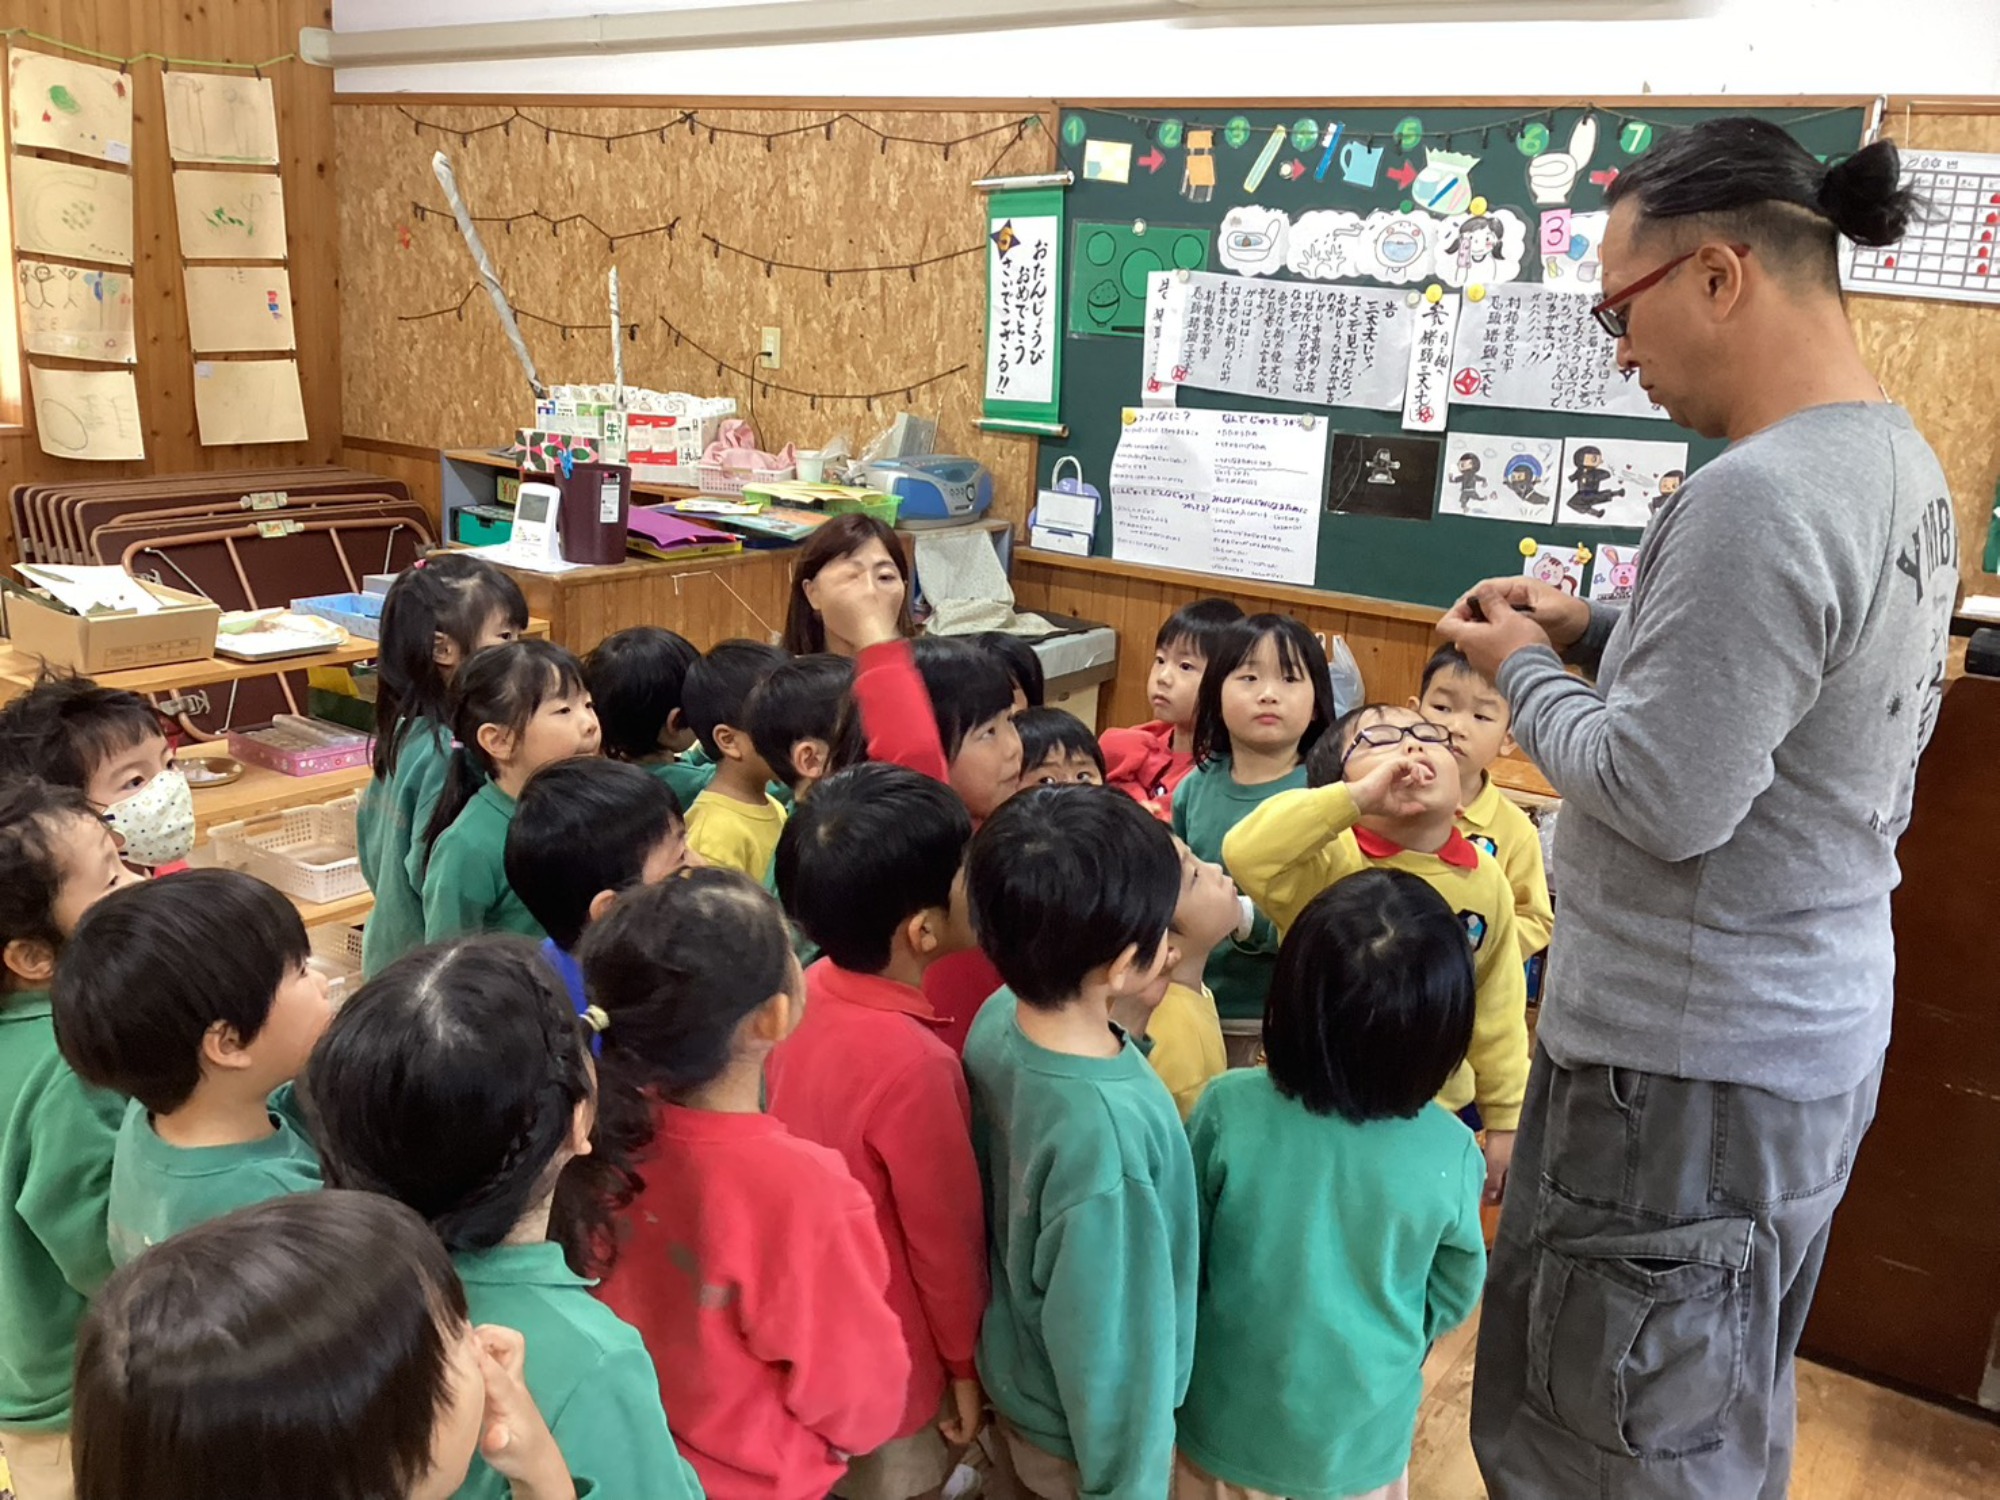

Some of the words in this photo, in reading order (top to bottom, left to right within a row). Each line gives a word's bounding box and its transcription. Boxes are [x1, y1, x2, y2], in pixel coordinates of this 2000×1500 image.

[1067, 119, 1078, 142] 1
[1164, 122, 1179, 145] 2
[1231, 120, 1246, 144] 3
[1402, 121, 1418, 145] 5
[1524, 126, 1541, 152] 6
[1627, 123, 1647, 152] 7
[1547, 216, 1565, 246] 3
[1029, 239, 1048, 365] おたんじょうび
[1014, 266, 1030, 365] おめでとう
